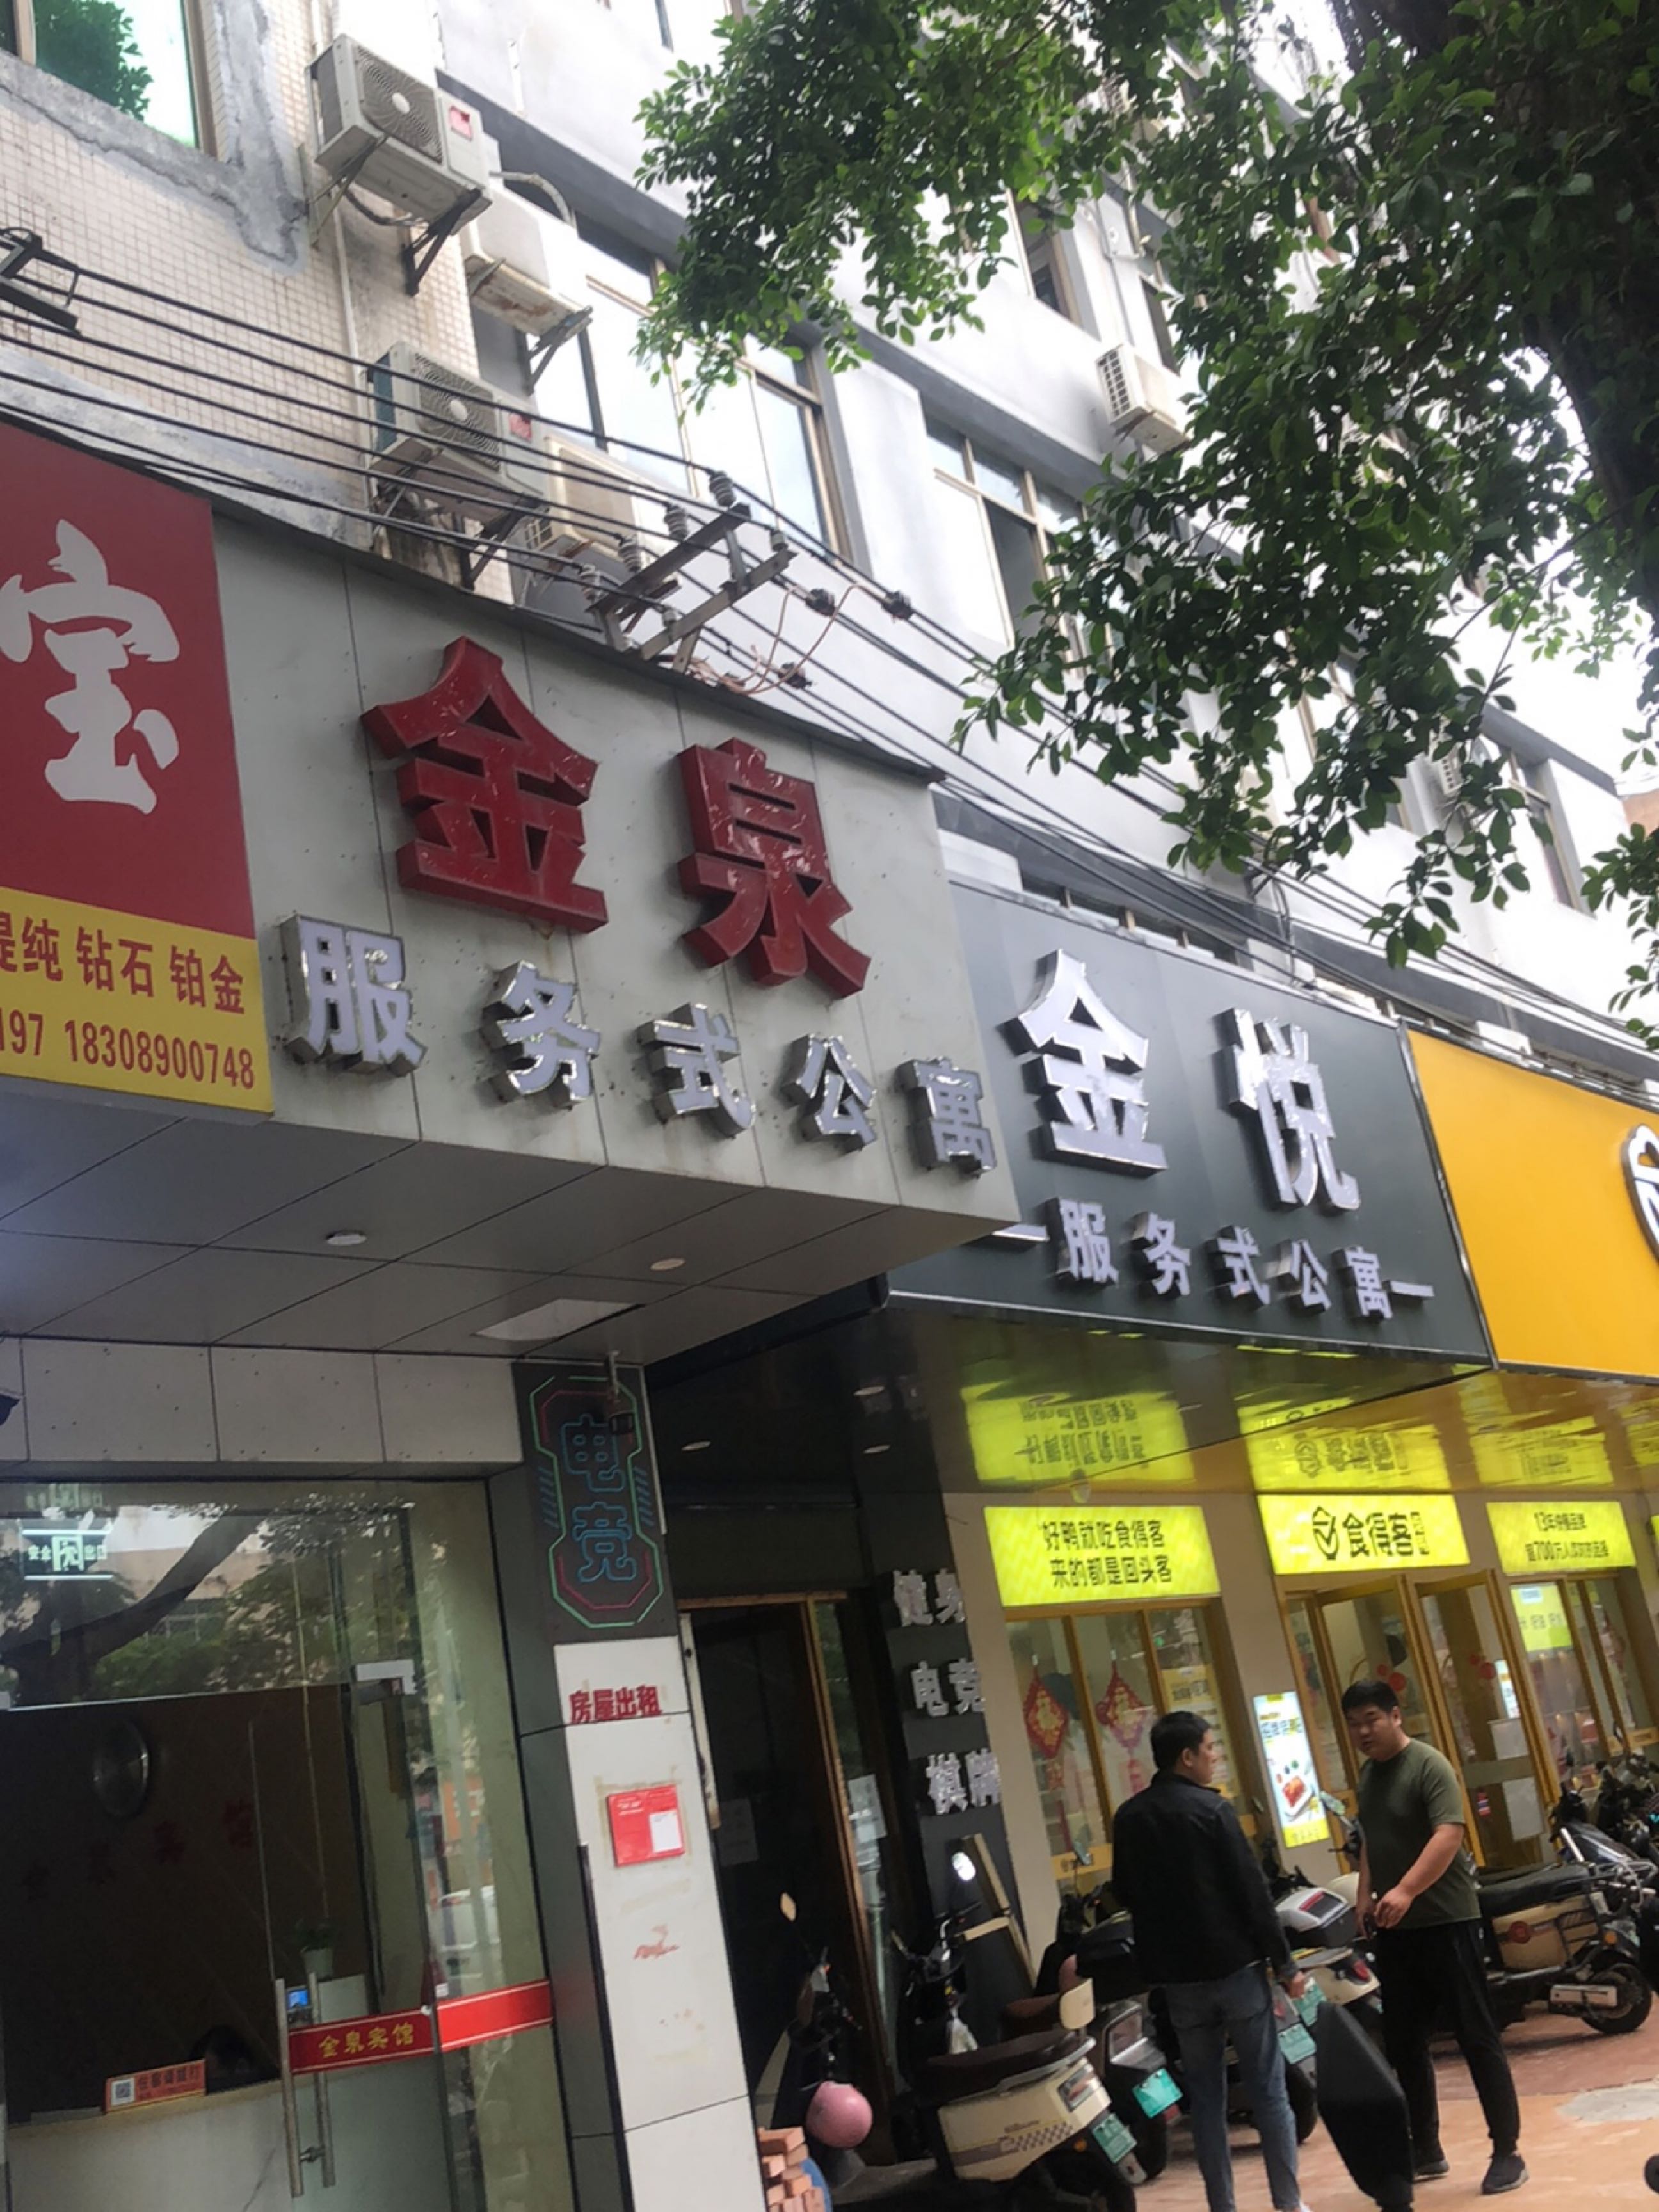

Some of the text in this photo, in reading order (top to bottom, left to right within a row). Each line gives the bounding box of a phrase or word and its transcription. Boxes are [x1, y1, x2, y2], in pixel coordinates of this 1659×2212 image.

[0, 519, 180, 815] 宝
[360, 634, 871, 998] 金泉
[76, 926, 154, 997] 钻石
[169, 945, 245, 1014] 铂金
[65, 1019, 255, 1089] 18308900748
[280, 914, 997, 1178] 服务式公寓
[1004, 949, 1361, 1213] 金悦
[1050, 1555, 1172, 1589] 来的都是回头客
[569, 1683, 662, 1724] 房屋出租
[319, 2021, 415, 2058] 金泉宾馆
